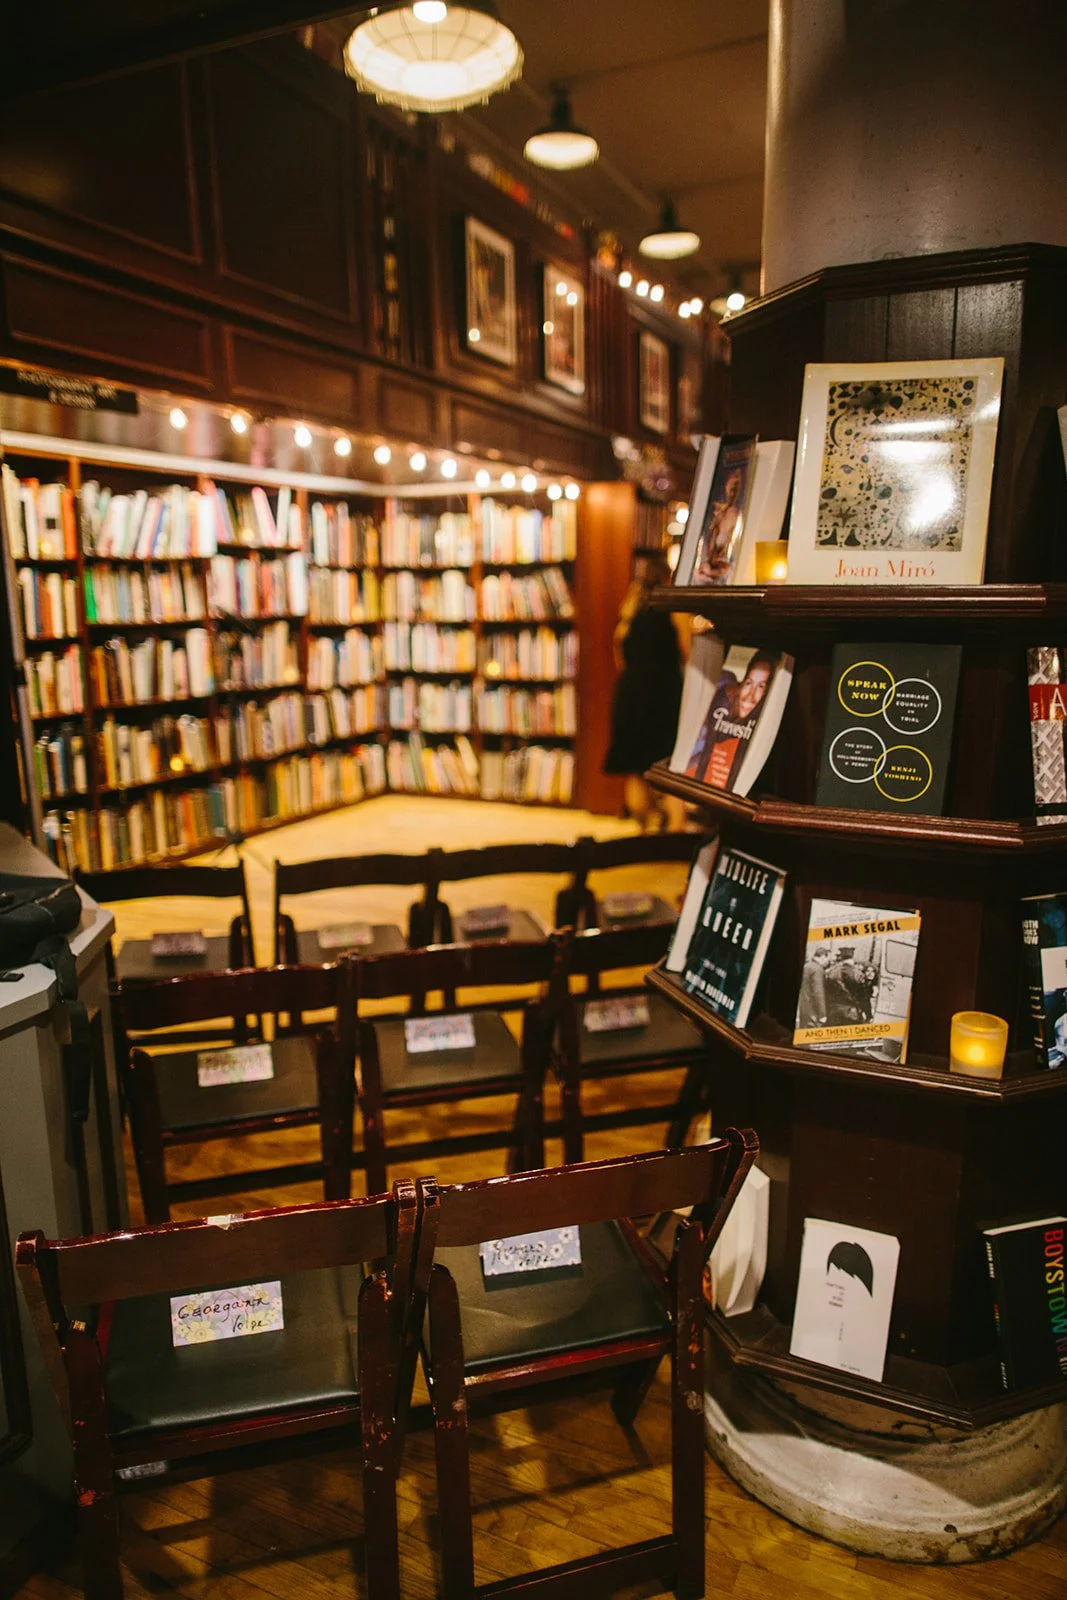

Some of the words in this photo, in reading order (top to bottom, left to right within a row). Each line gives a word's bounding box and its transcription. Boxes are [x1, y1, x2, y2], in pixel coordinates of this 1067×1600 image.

[835, 559, 878, 578] Joan
[885, 559, 935, 578] Miró
[847, 680, 887, 690] SPEAK
[851, 692, 880, 701] NOW
[896, 692, 930, 701] MARRIAGE
[895, 701, 929, 709] EQUALITY
[891, 765, 917, 774] KENJI
[824, 925, 859, 939] MARK
[864, 920, 900, 934] SEGAL
[805, 1028, 824, 1038] AND
[826, 1027, 847, 1036] THEN
[855, 1024, 890, 1034] DANCED
